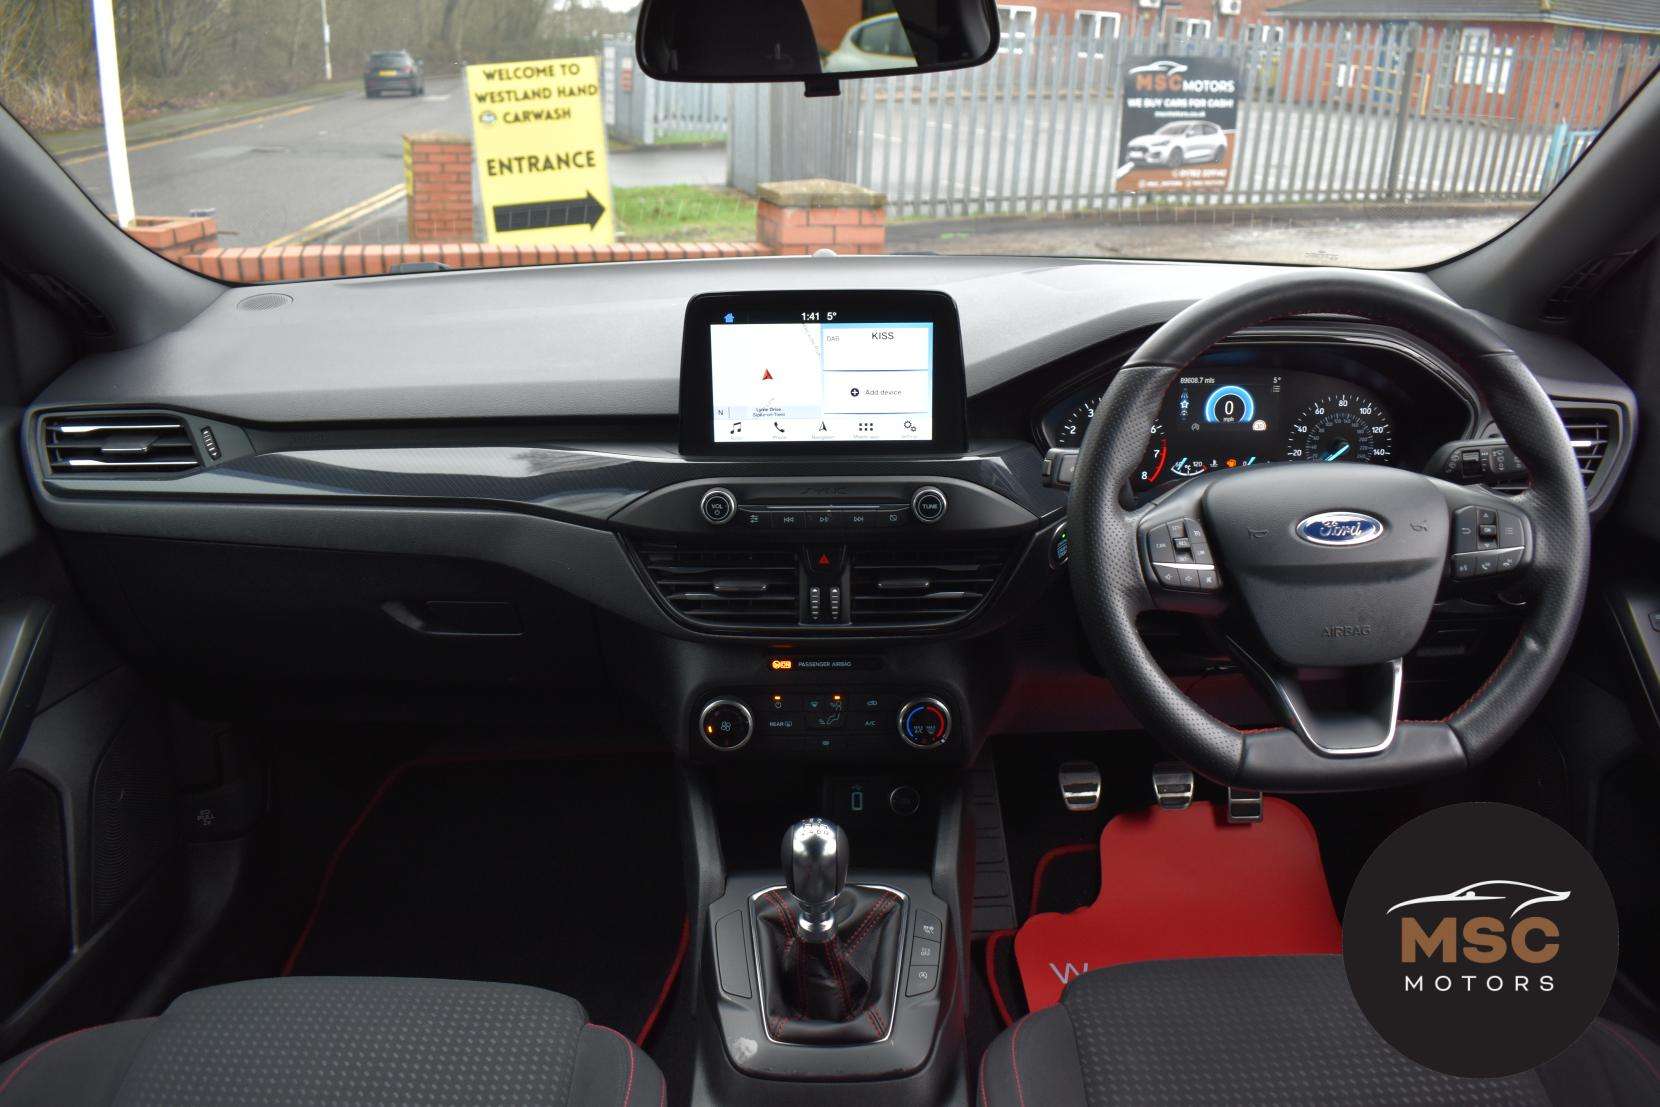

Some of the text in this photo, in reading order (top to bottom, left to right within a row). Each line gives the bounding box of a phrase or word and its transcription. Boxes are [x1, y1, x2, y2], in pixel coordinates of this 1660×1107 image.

[483, 64, 580, 81] WELCOME TO
[1136, 74, 1236, 92] MSC MOTORS
[475, 84, 598, 104] WESTLAND HAND
[502, 108, 572, 124] CARWASH
[486, 151, 597, 176] ENTRANCE
[802, 312, 820, 320] 1:41
[872, 332, 894, 340] KISS
[1088, 409, 1094, 417] 3
[1225, 400, 1234, 415] 0
[1070, 426, 1076, 434] 2
[1320, 520, 1362, 536] Ford
[1320, 624, 1370, 638] AIRBAG
